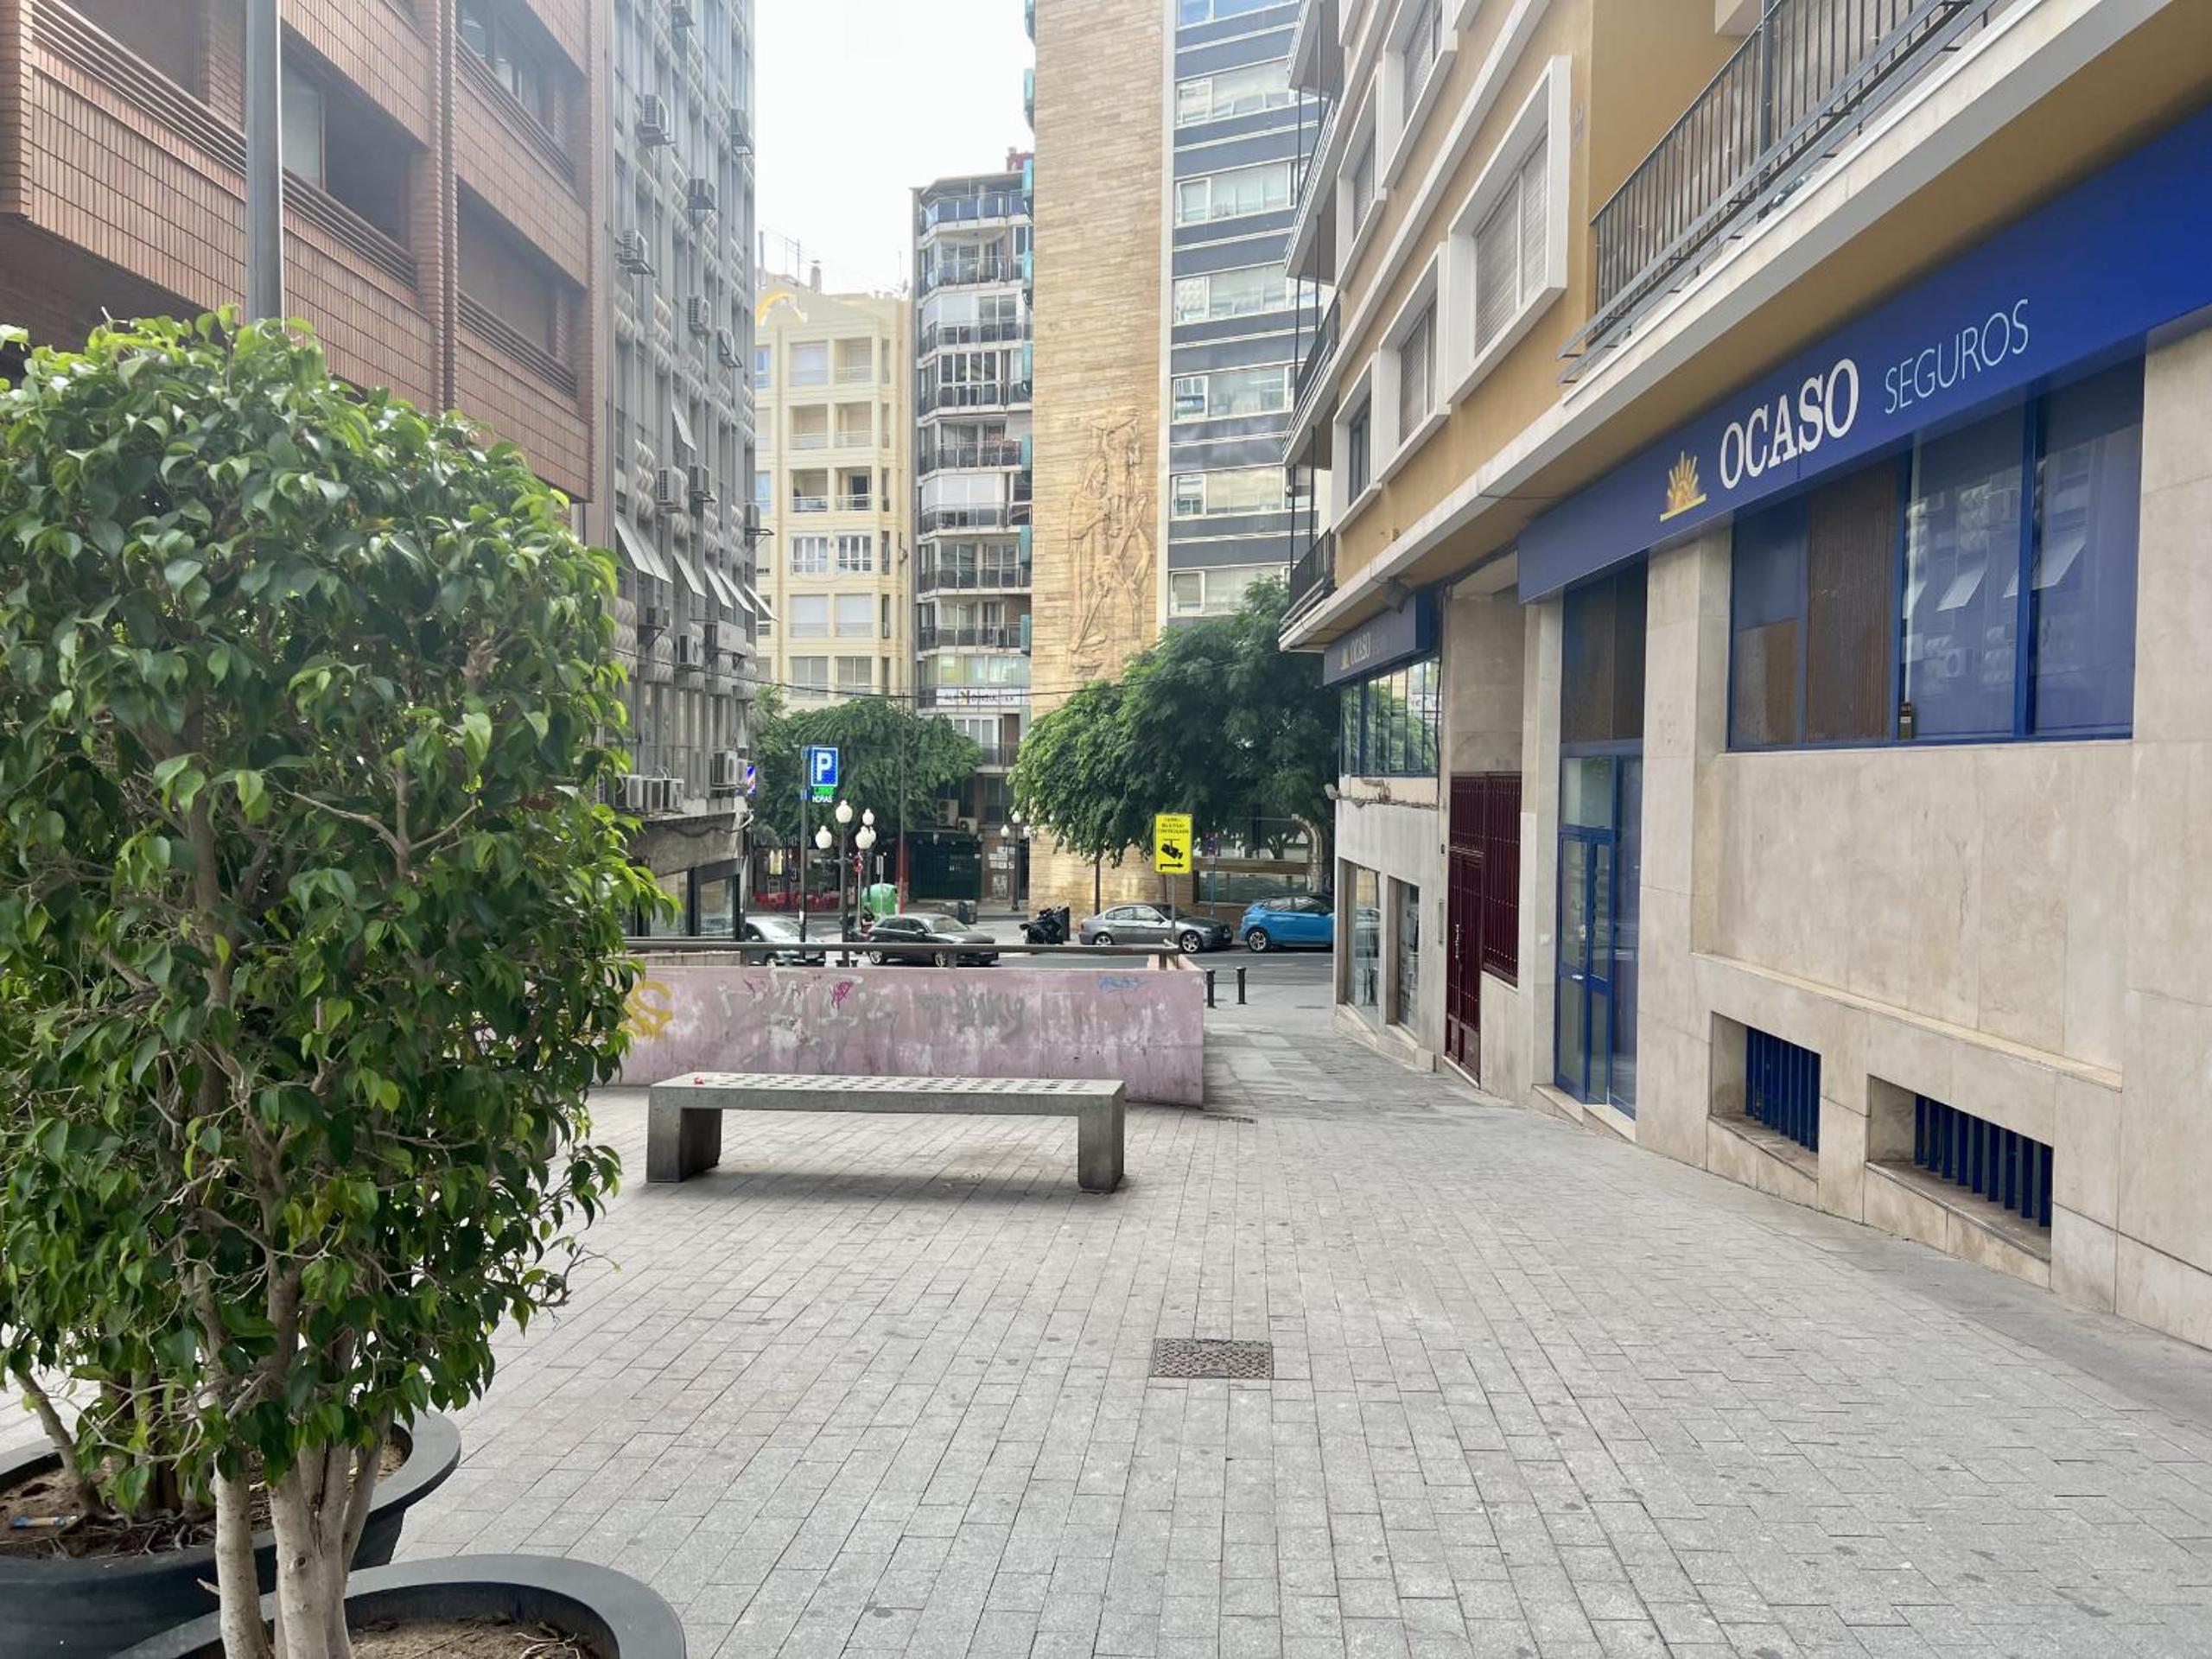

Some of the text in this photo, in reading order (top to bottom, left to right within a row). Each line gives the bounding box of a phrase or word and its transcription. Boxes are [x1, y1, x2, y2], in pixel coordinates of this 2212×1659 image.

[1719, 298, 2030, 489] OCASO SEGUROS
[1350, 632, 1371, 664] OCASO
[817, 752, 832, 781] P
